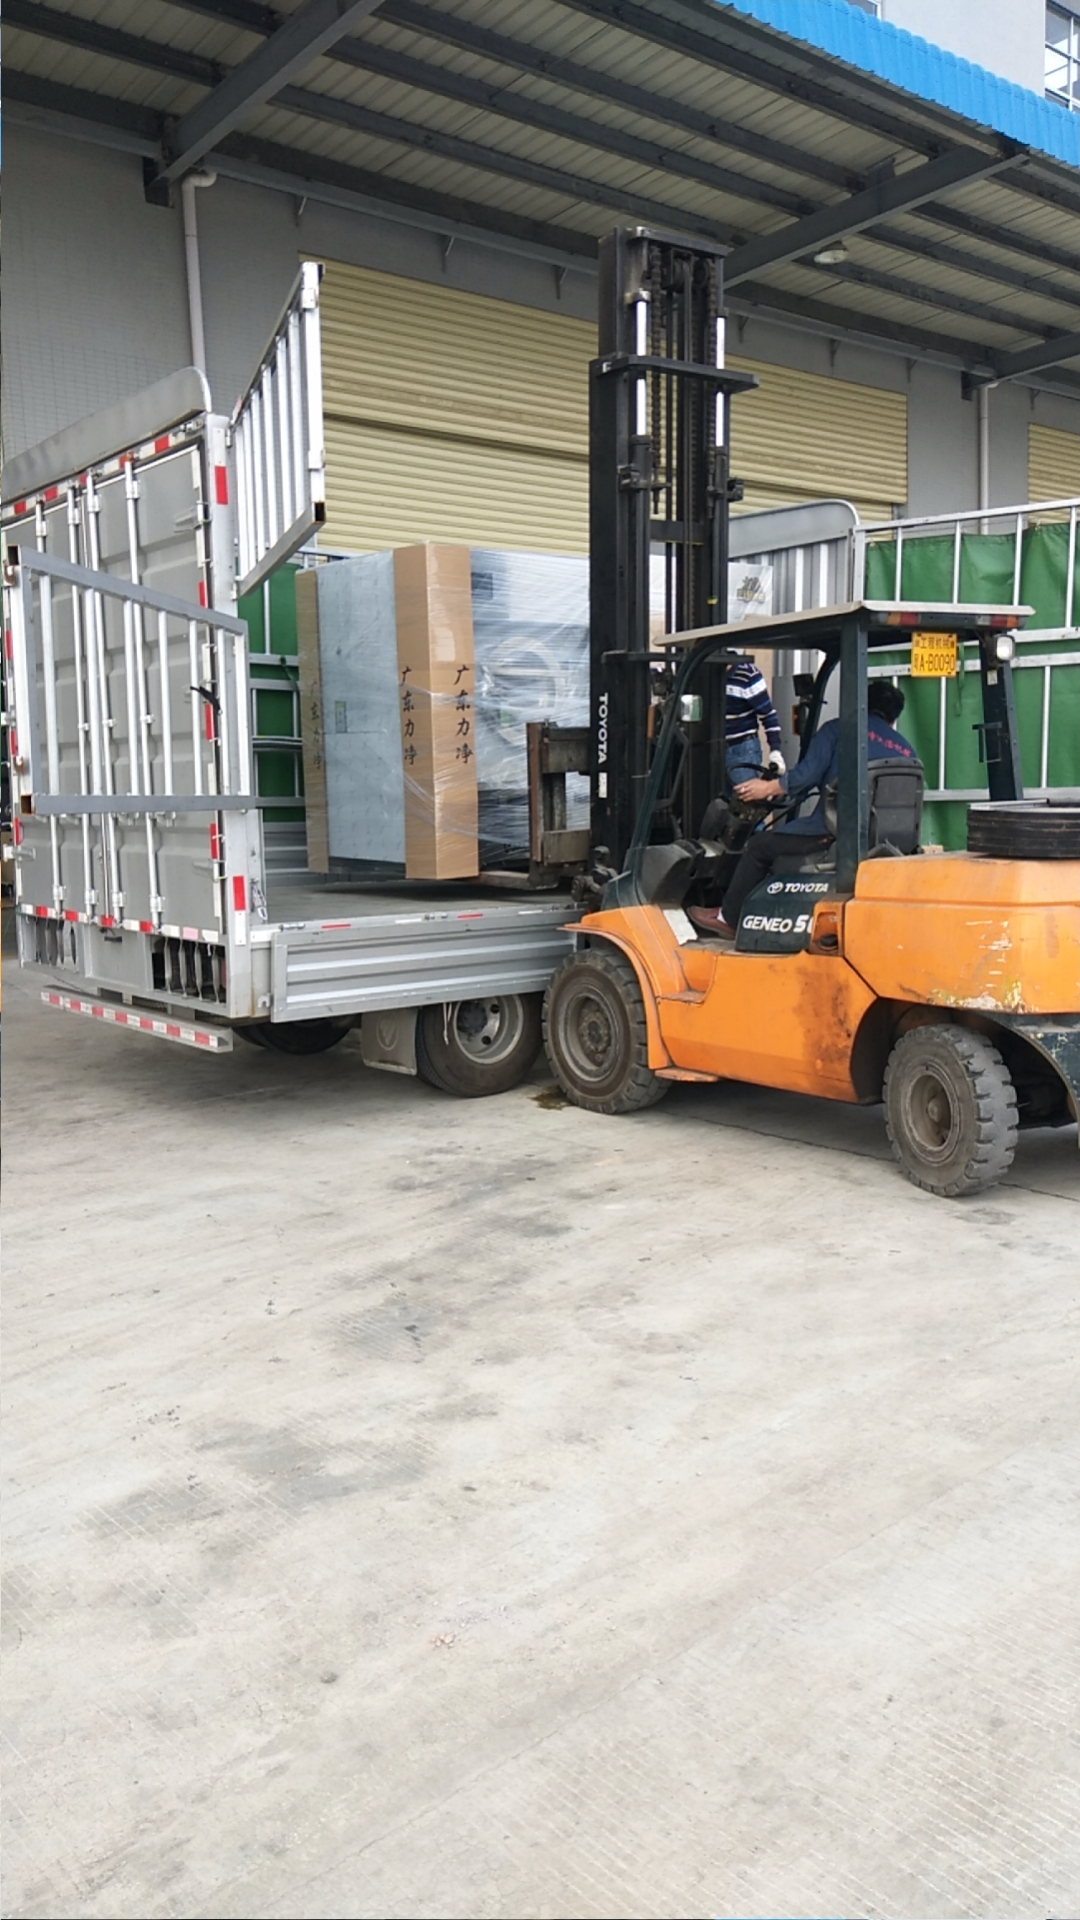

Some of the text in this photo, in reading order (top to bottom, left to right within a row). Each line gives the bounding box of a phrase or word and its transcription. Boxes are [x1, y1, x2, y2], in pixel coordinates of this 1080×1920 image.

[400, 666, 418, 765] 广东力净
[453, 664, 473, 764] 广东力净
[598, 692, 608, 764] TOYOTA
[742, 914, 792, 933] GENEO
[784, 882, 829, 893] TOYOTA
